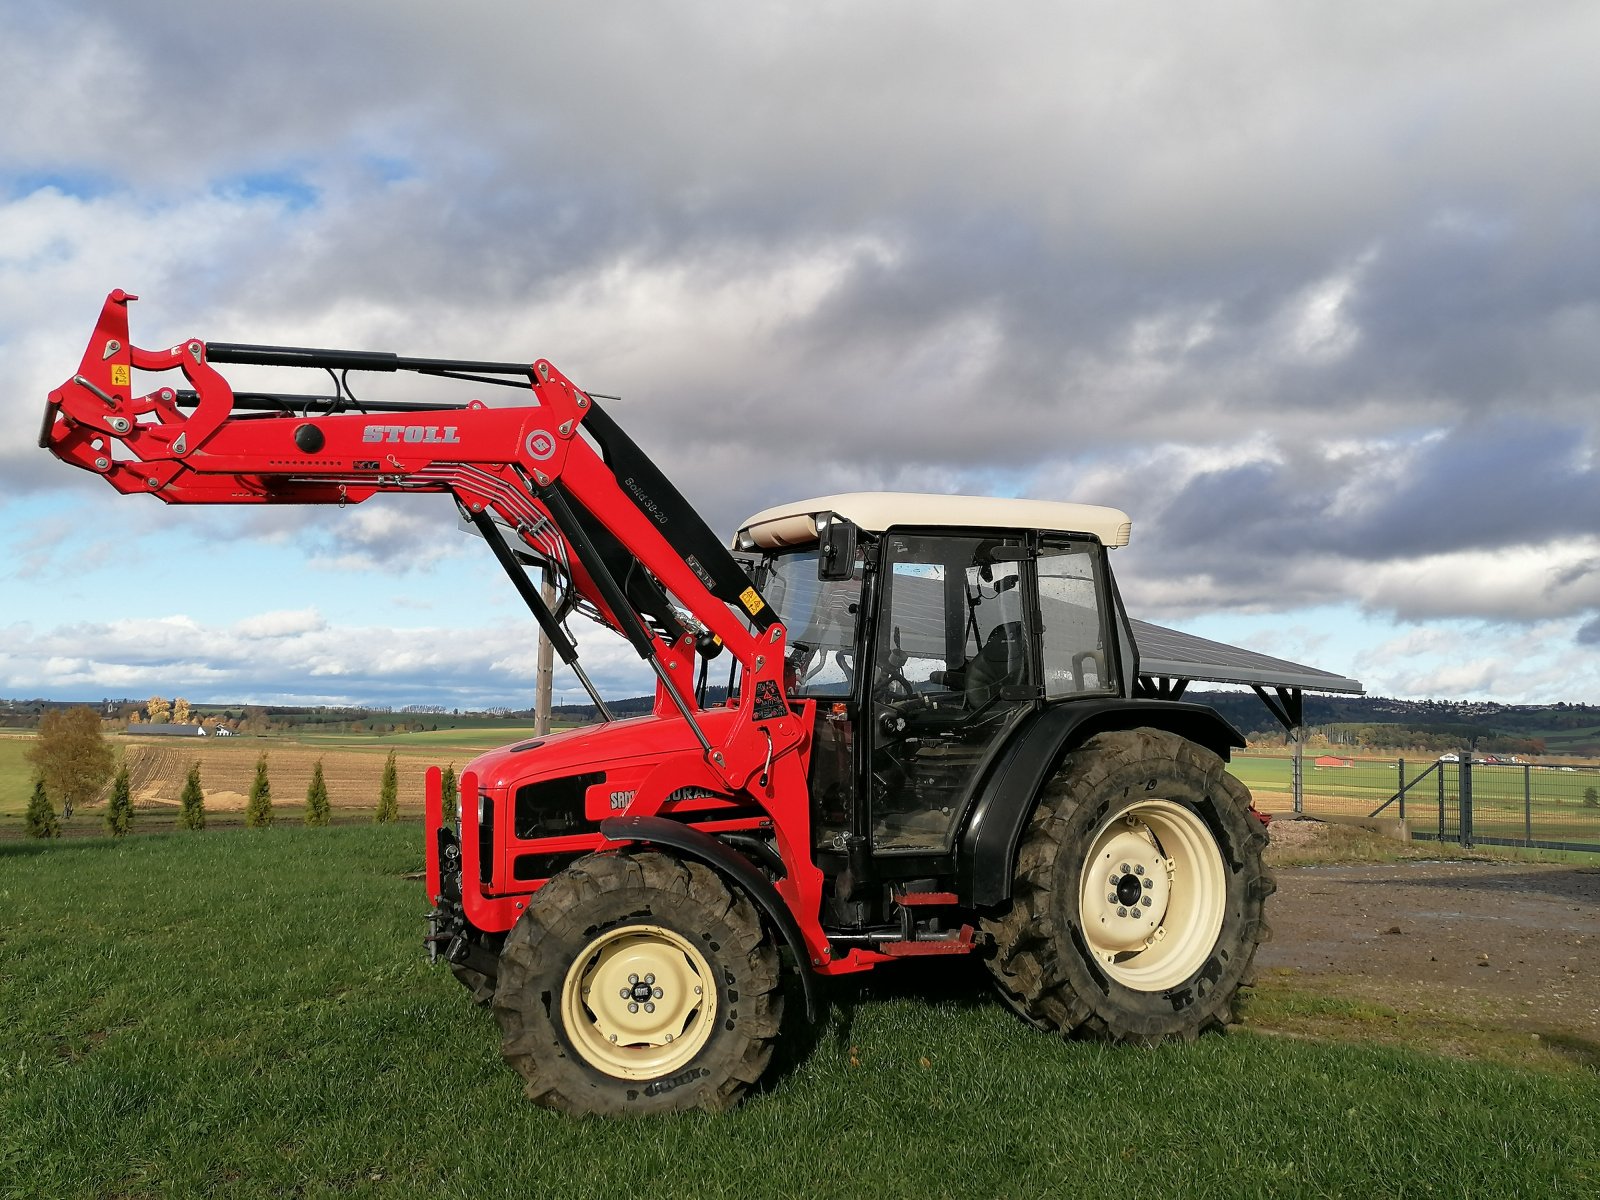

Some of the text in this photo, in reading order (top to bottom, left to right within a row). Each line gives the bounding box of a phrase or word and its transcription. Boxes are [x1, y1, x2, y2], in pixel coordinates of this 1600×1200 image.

[362, 425, 460, 443] STOLL
[644, 499, 668, 524] 38-20
[610, 789, 638, 810] SAM
